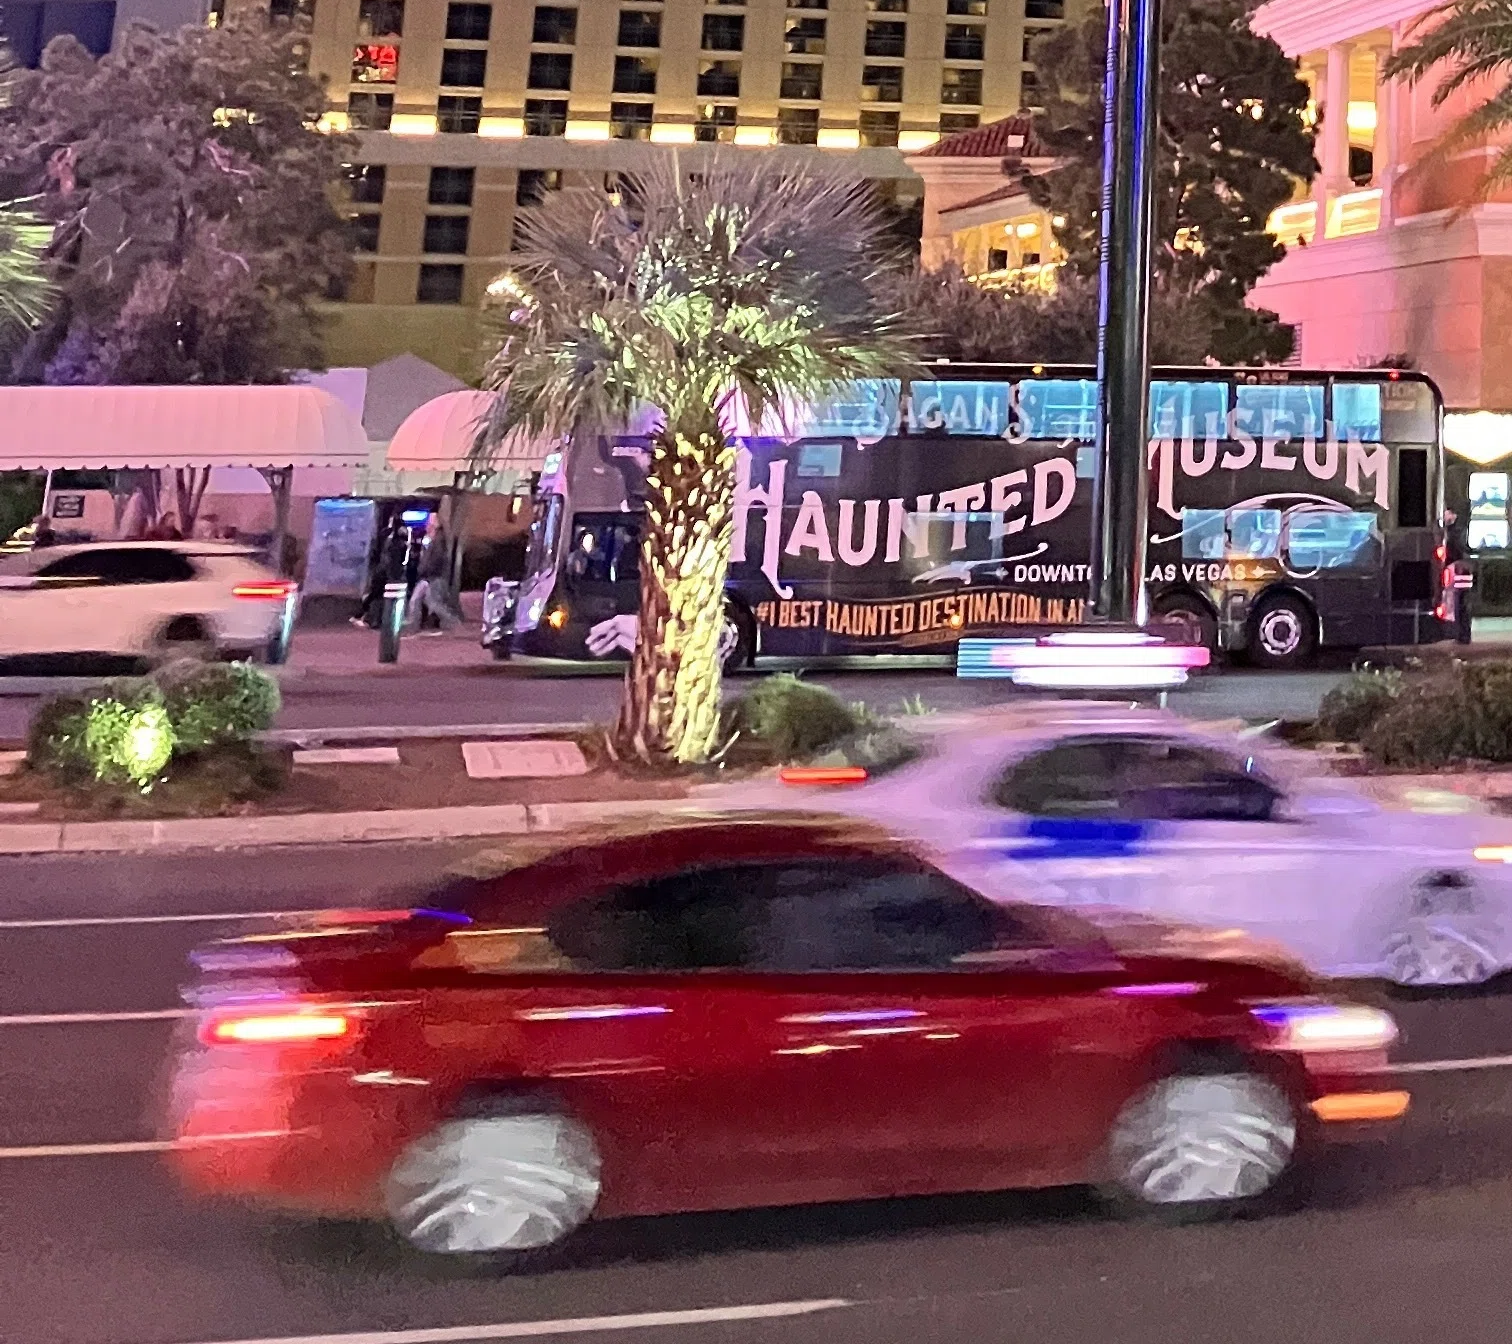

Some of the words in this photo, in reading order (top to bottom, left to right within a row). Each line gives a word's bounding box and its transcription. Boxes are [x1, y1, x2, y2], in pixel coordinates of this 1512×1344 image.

[730, 438, 1077, 600] HAUNTED
[1014, 564, 1108, 583] DOWNT
[1181, 563, 1248, 582] VEGAS
[778, 600, 823, 628] BEST
[826, 599, 915, 637] HAUNTED
[918, 592, 1042, 631] DESTINATION
[1047, 598, 1064, 624] IN
